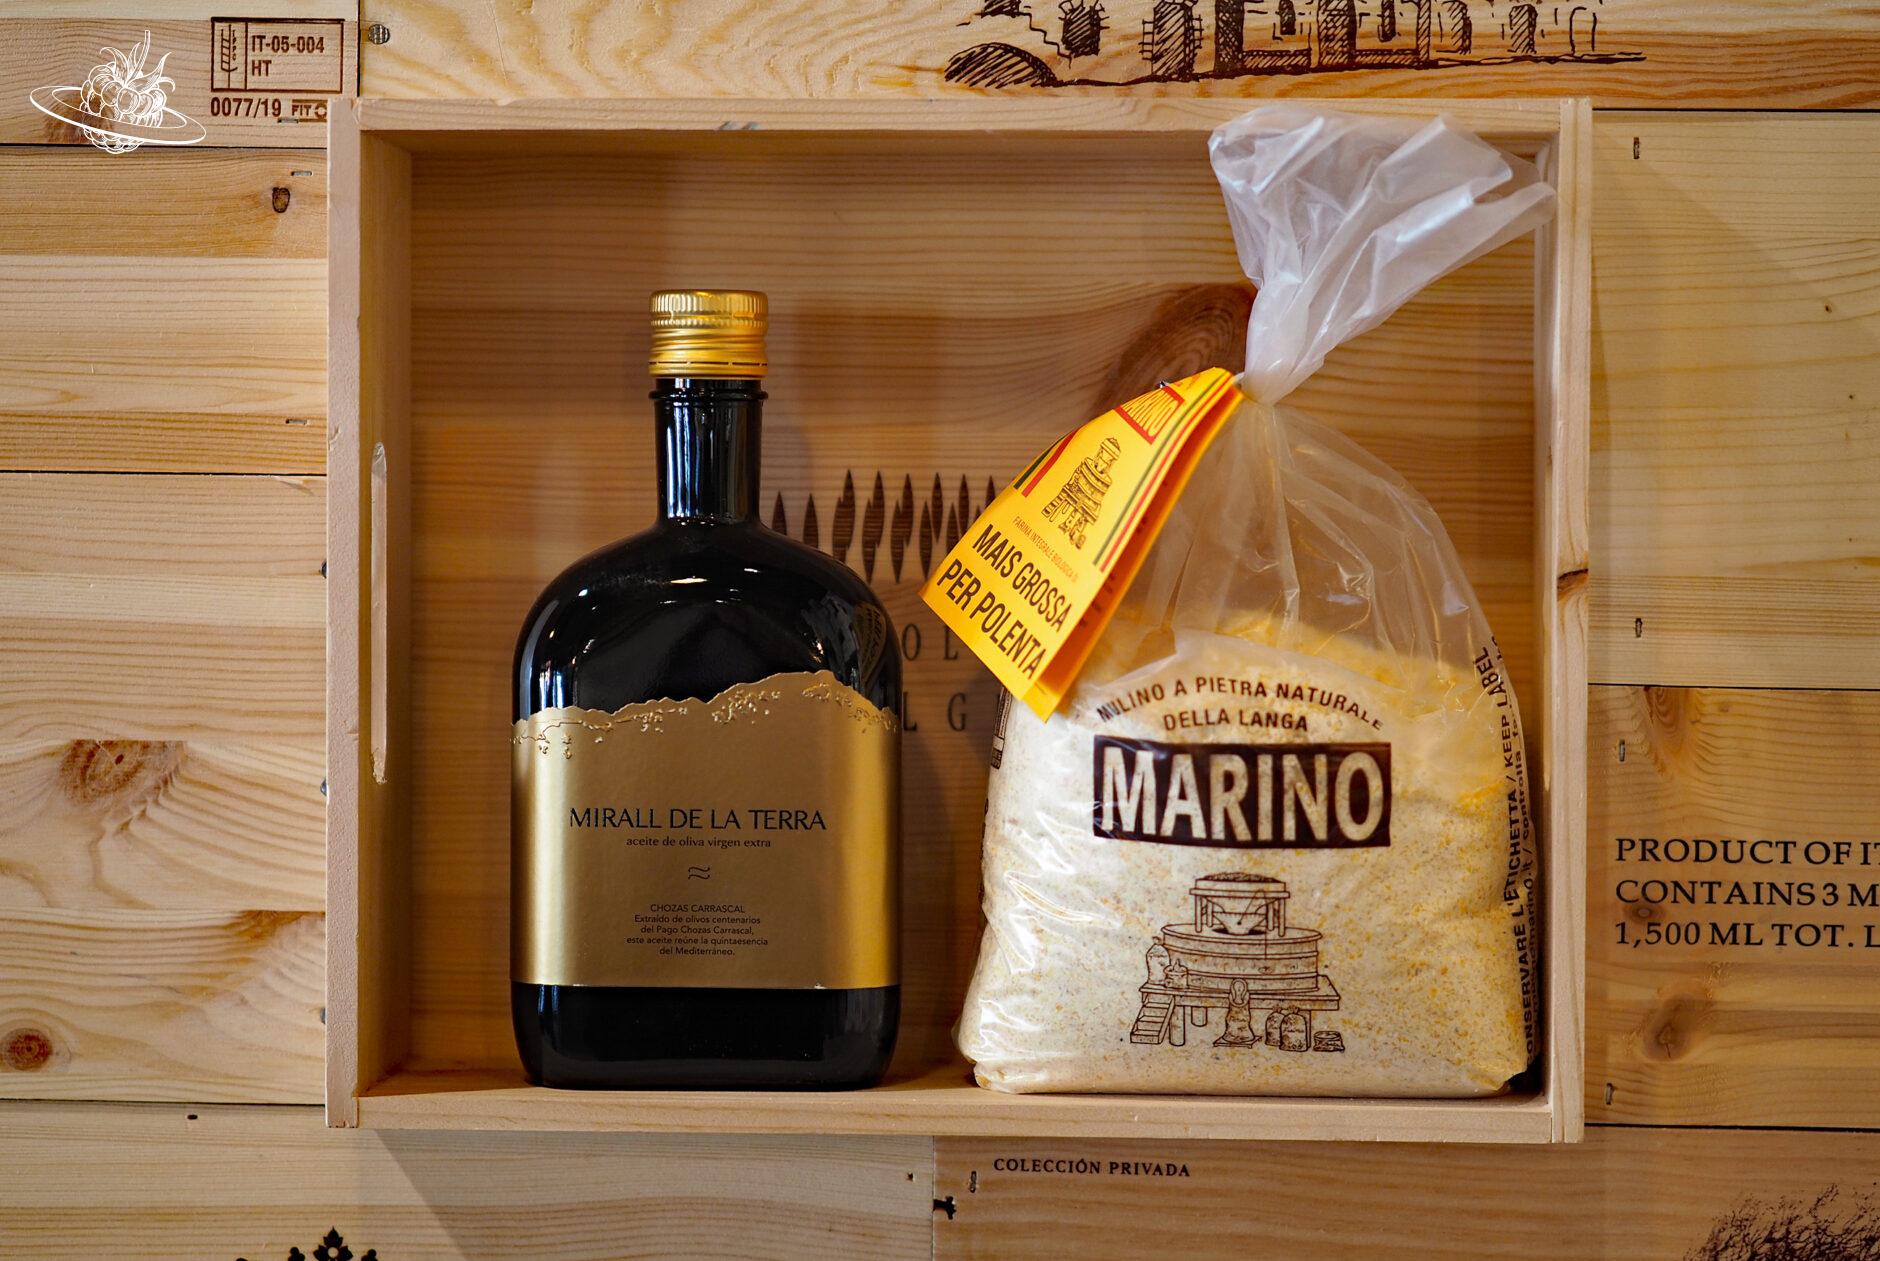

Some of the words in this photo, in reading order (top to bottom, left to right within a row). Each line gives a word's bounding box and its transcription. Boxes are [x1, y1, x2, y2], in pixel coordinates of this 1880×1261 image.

[252, 35, 325, 53] IT-05-004
[252, 60, 272, 77] HT
[210, 97, 282, 118] 0077/19
[972, 524, 1022, 579] MAIS
[1012, 562, 1073, 633] GROSSA
[936, 559, 982, 612] PER
[969, 576, 1048, 681] POLENTA
[1475, 646, 1508, 708] LABEL
[1096, 683, 1165, 723] MULINO
[1174, 680, 1188, 697] A
[1195, 677, 1268, 698] PIETRA
[1275, 683, 1384, 731] NATURALE
[1163, 708, 1230, 731] DELLA
[1239, 709, 1309, 732] LANGA
[1501, 714, 1513, 768] KEEP
[1101, 746, 1384, 842] MARINO
[1515, 750, 1529, 840] controlla
[570, 807, 662, 829] MIRALL
[669, 808, 702, 829] DE
[710, 809, 741, 829] LA
[748, 809, 827, 830] TERRA
[626, 837, 659, 847] aceite
[662, 836, 676, 847] de
[679, 836, 704, 847] oliva
[707, 837, 741, 849] virgen
[744, 838, 771, 848] extra
[1504, 788, 1524, 917] L'ETICHETTA
[1615, 838, 1797, 864] PRODUCT
[1803, 841, 1852, 865] OF
[1615, 879, 1816, 905] CONTAINS
[1822, 883, 1840, 906] 3
[634, 914, 670, 923] Extraído
[672, 915, 683, 923] de
[685, 915, 710, 924] olivos
[712, 916, 761, 925] centenarios
[650, 904, 689, 912] CHOZAS
[691, 904, 745, 913] CARRASCAL
[640, 925, 654, 933] del
[656, 925, 678, 935] Pago
[680, 925, 711, 934] Chozas
[713, 926, 755, 936] Carrascal,
[646, 936, 673, 944] aceite
[674, 935, 699, 944] reúne
[700, 936, 708, 944] la
[710, 936, 769, 946] quintaesencia
[1615, 921, 1700, 948] 1,500
[1708, 922, 1764, 945] ML
[1771, 923, 1854, 947] TOT.
[1513, 924, 1533, 1066] CONSERVARE
[993, 1157, 1101, 1174] COLECCIÓN
[1108, 1161, 1191, 1177] PRIVADA
